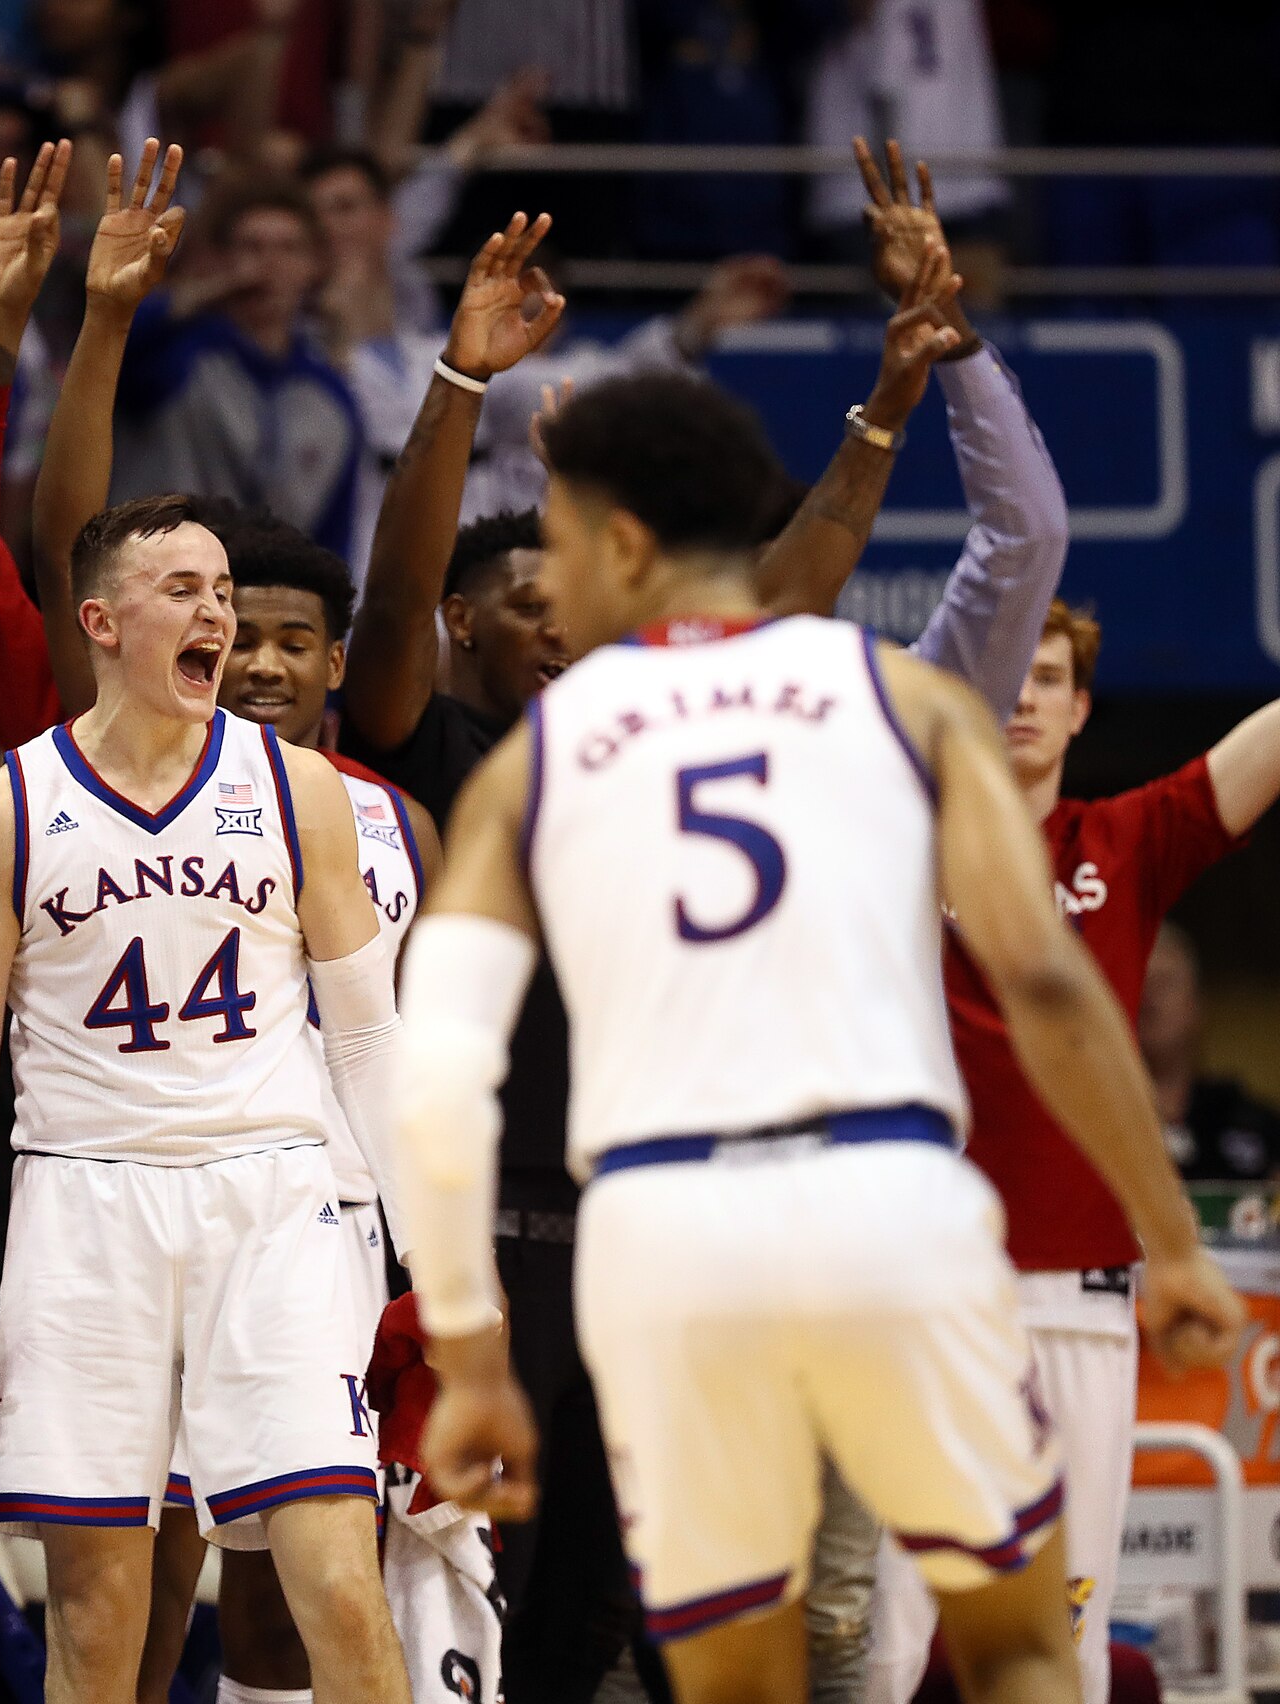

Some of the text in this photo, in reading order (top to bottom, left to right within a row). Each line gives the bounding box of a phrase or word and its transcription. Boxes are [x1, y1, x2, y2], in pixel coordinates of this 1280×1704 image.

[576, 683, 834, 774] GRIMES
[45, 821, 80, 837] adidas
[672, 752, 787, 942] 5
[40, 855, 276, 937] KANSAS
[83, 926, 257, 1054] 44
